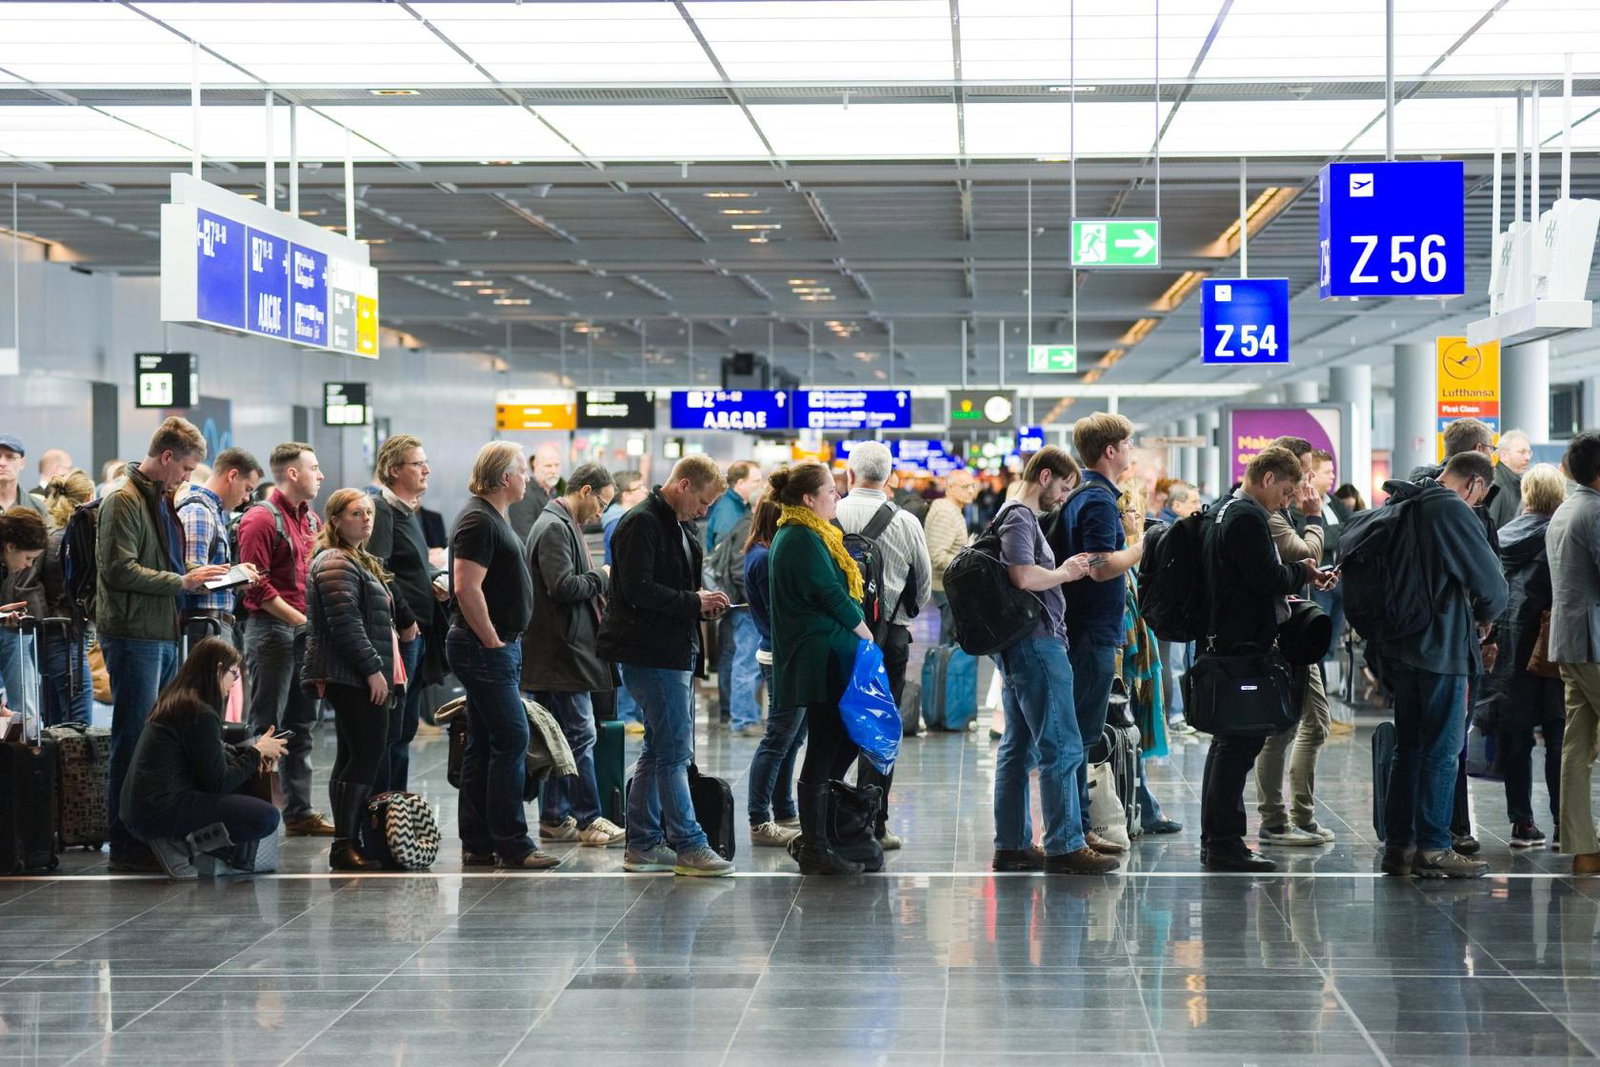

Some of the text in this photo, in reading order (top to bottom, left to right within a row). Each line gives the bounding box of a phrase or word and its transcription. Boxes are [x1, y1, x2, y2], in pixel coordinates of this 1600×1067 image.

[1349, 234, 1447, 284] Z 56
[1214, 324, 1279, 358] Z 54
[1442, 388, 1495, 398] Lufthansa
